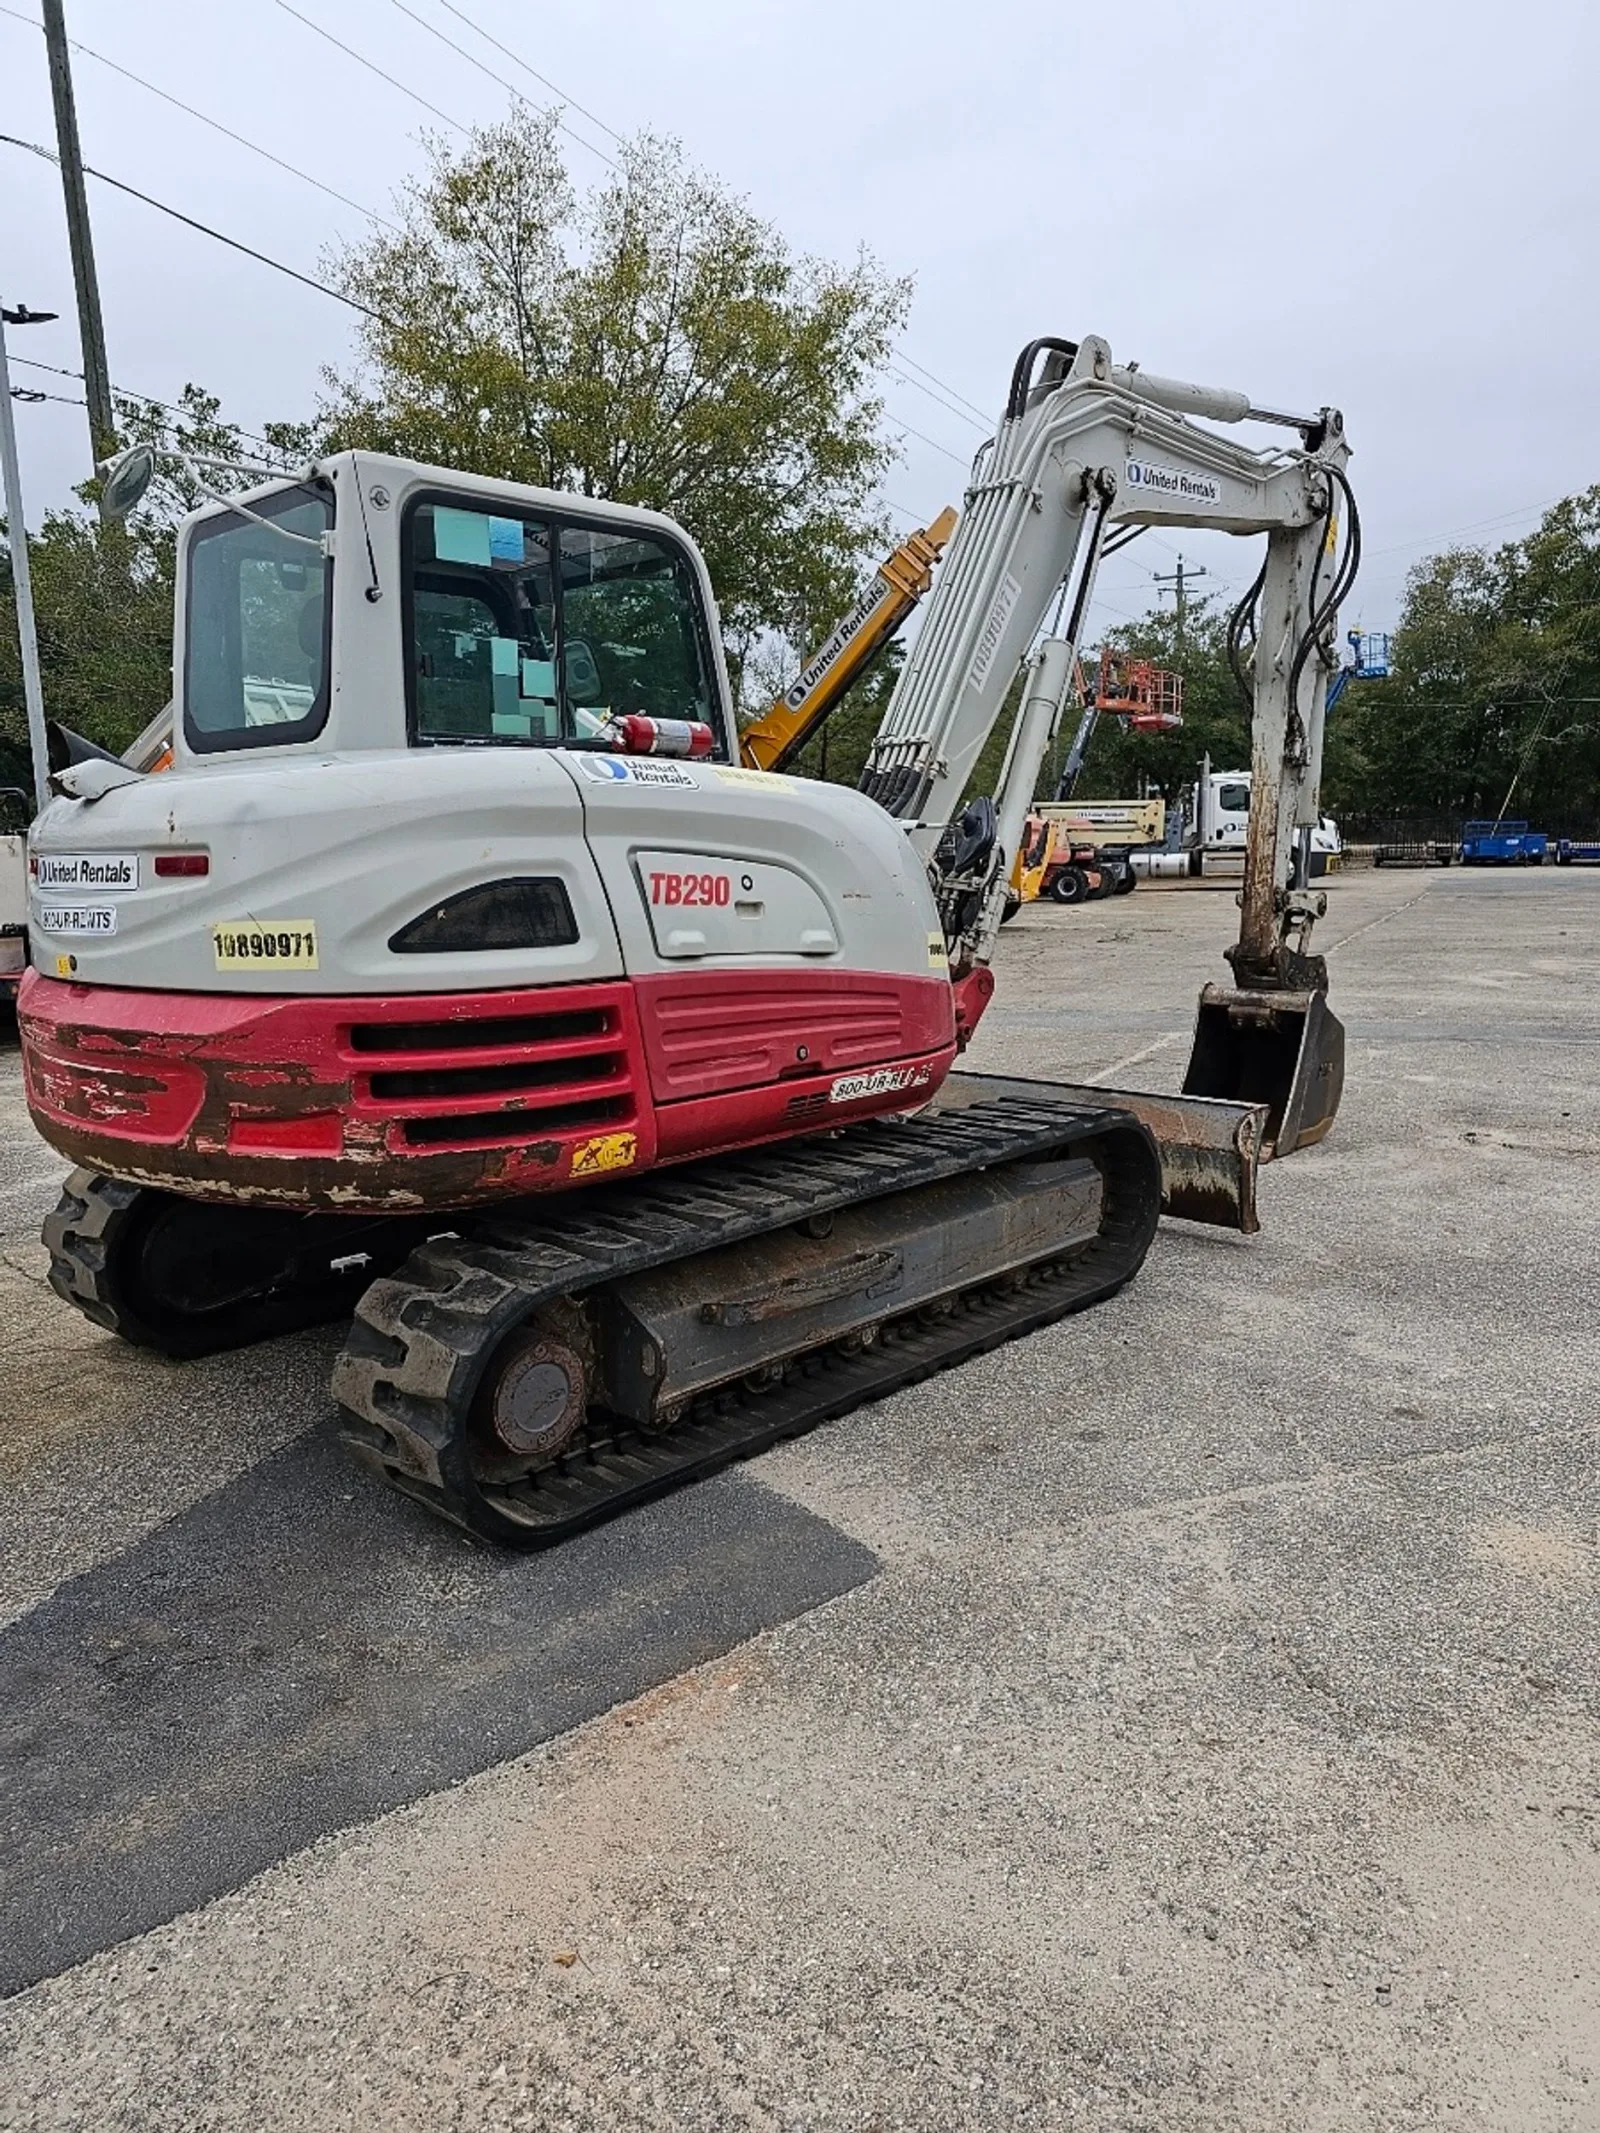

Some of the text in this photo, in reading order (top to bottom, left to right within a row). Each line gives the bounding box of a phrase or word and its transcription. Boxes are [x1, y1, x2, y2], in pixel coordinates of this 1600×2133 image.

[1144, 468, 1215, 499] United Rentals
[803, 584, 886, 688] United Rentals
[625, 760, 677, 774] United
[632, 771, 691, 785] Rentals
[47, 860, 131, 882] United Rentals
[649, 872, 730, 906] TB290
[213, 932, 314, 957] 10890971
